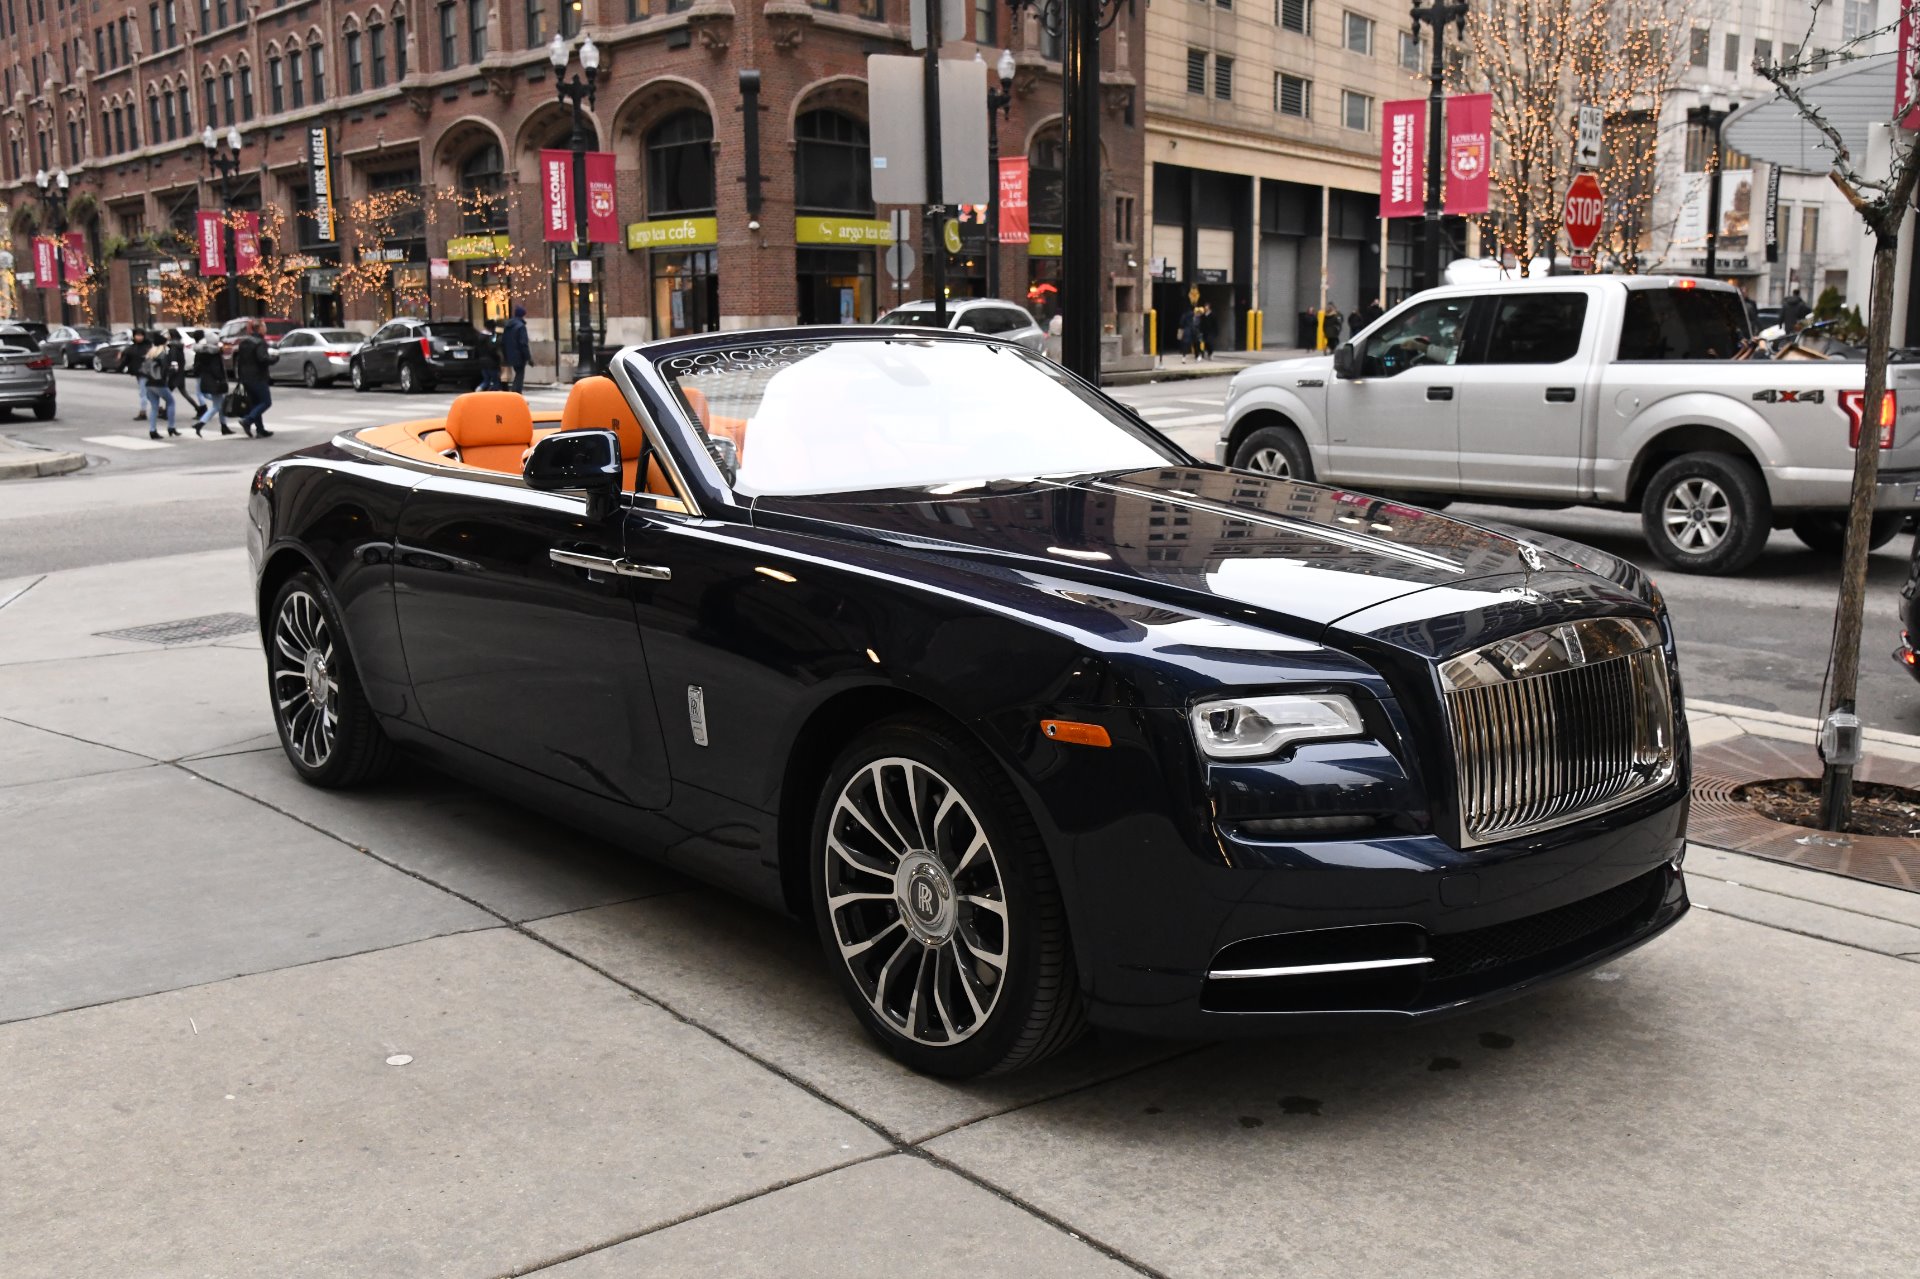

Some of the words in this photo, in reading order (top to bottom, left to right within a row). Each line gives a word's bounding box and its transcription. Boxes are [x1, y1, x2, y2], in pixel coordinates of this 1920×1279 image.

[1581, 110, 1600, 127] ONE
[1451, 133, 1485, 144] LOYOLA
[1581, 128, 1600, 143] WAY
[312, 129, 325, 166] BAGELS
[1391, 114, 1407, 203] WELCOME
[549, 161, 562, 231] WELCOME
[1567, 198, 1601, 226] STOP
[668, 219, 697, 240] café
[839, 227, 863, 243] argo
[865, 226, 878, 239] tea
